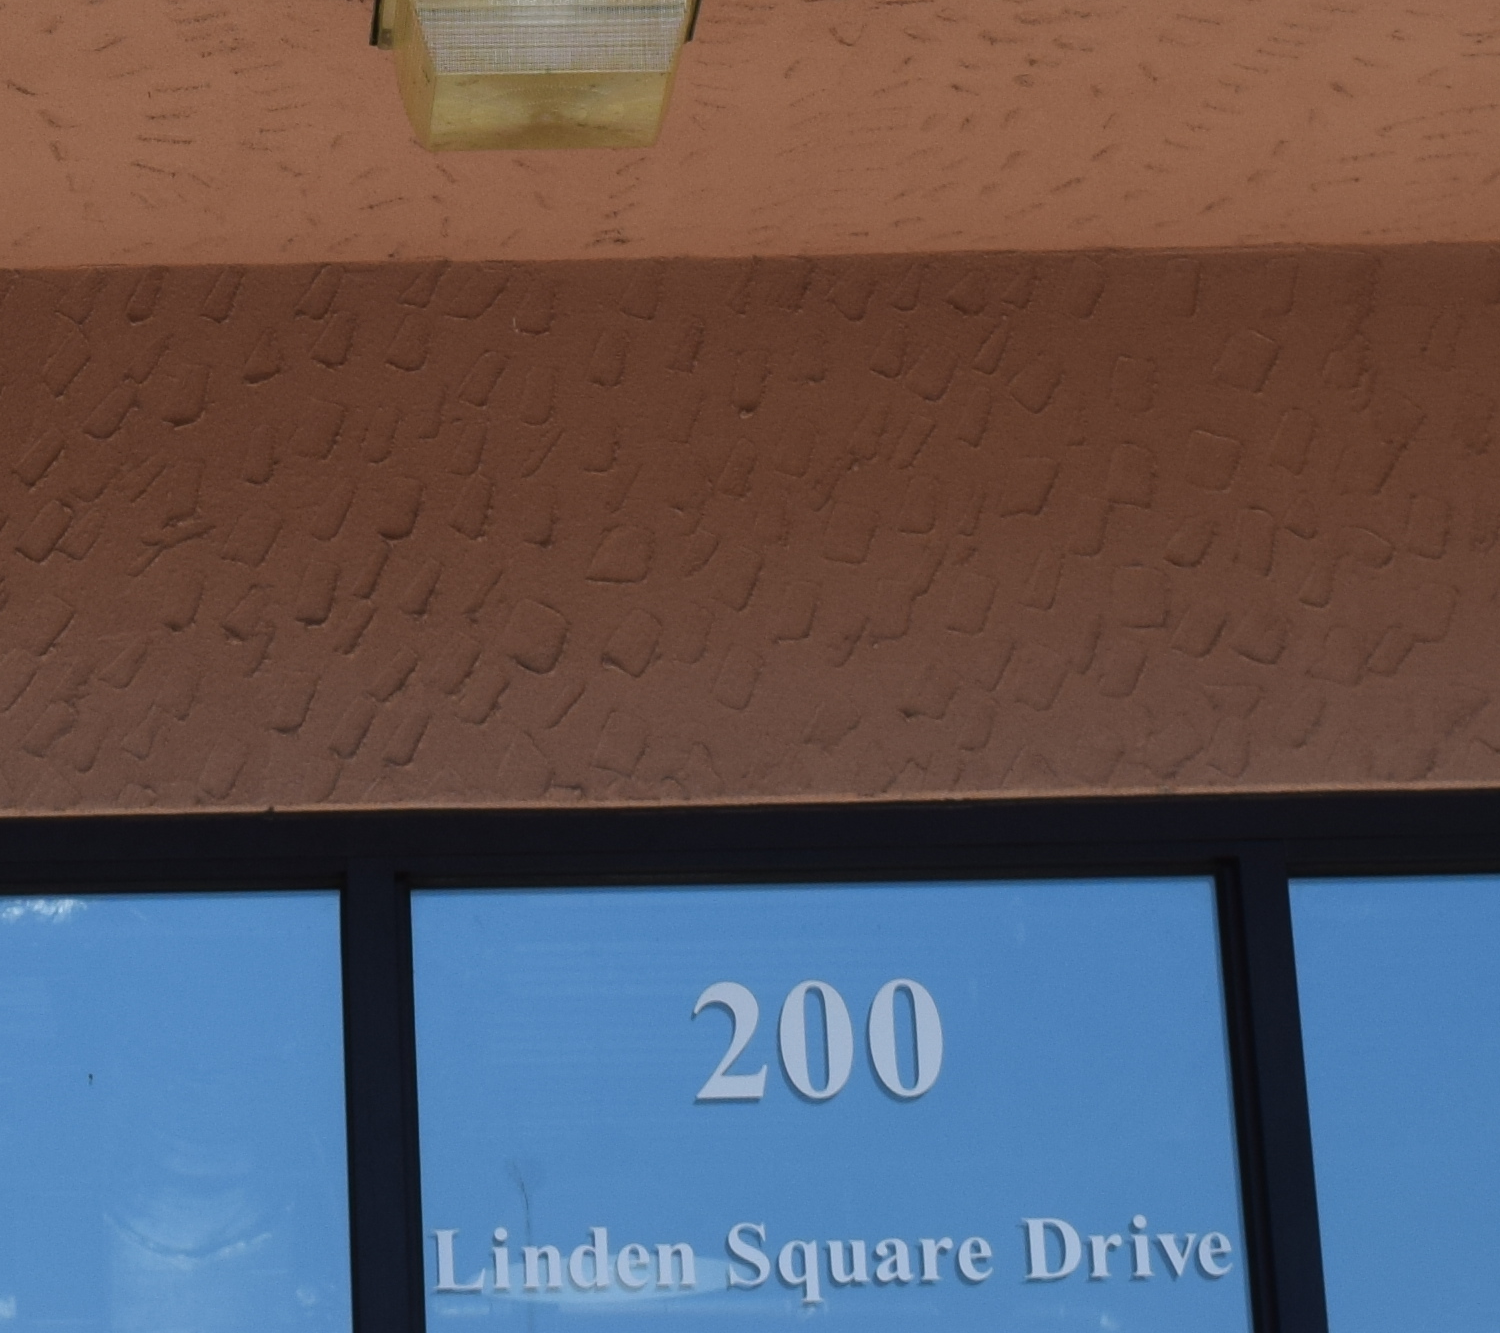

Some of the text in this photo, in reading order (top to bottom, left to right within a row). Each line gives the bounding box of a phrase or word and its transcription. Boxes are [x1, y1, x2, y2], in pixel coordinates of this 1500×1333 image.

[691, 977, 943, 1103] 200
[433, 1213, 1235, 1304] Linden Square Drive
